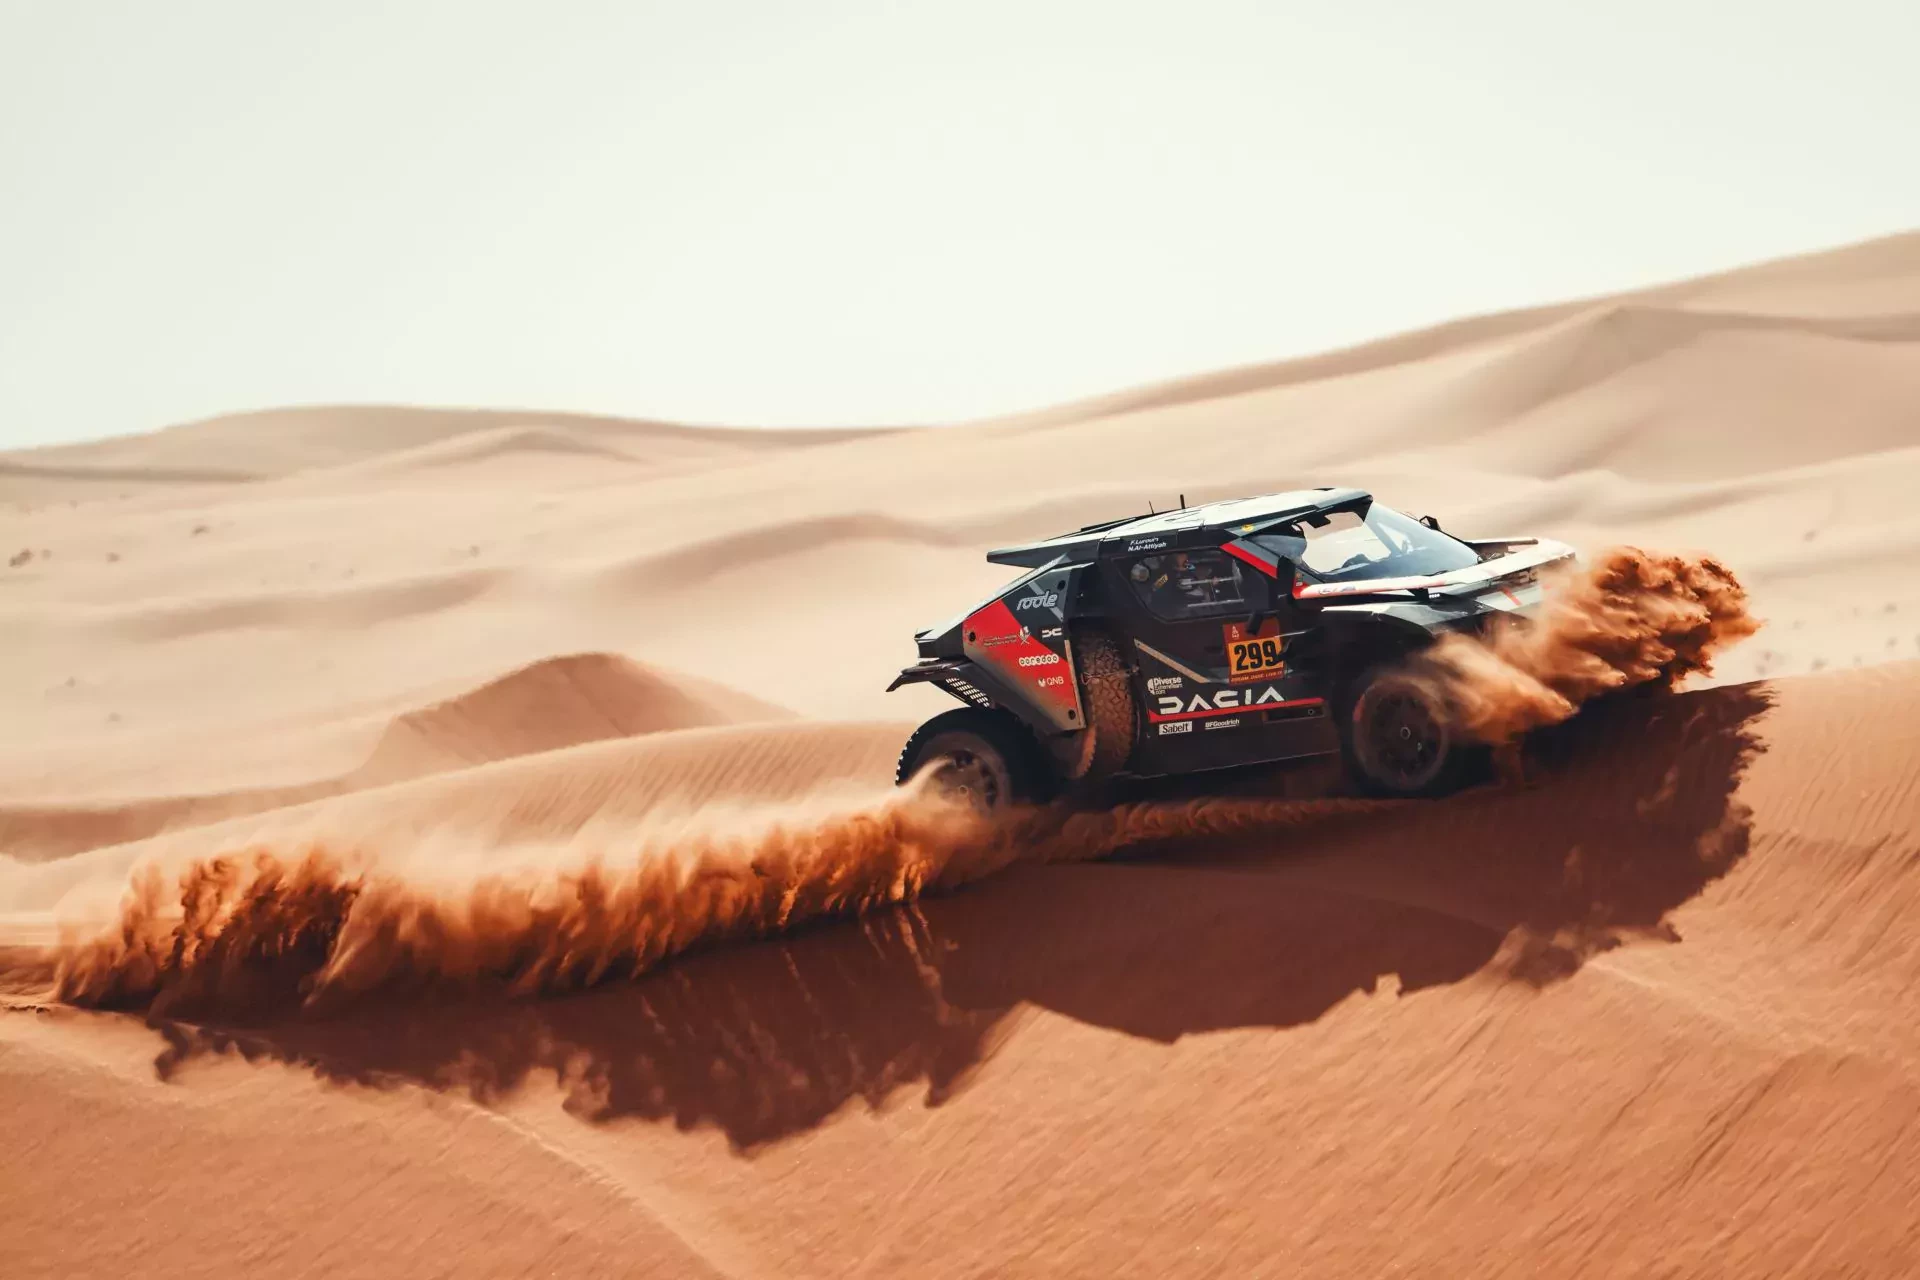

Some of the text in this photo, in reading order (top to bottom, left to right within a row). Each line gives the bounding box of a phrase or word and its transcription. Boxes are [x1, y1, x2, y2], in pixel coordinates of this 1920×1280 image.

[1019, 654, 1059, 667] ooredoo
[1233, 640, 1280, 672] 299
[1046, 676, 1064, 686] QNB
[1153, 677, 1182, 687] Diverse
[1158, 685, 1285, 715] DACIA
[1162, 723, 1189, 734] Sabelt
[1204, 718, 1240, 728] BFGoodrich
